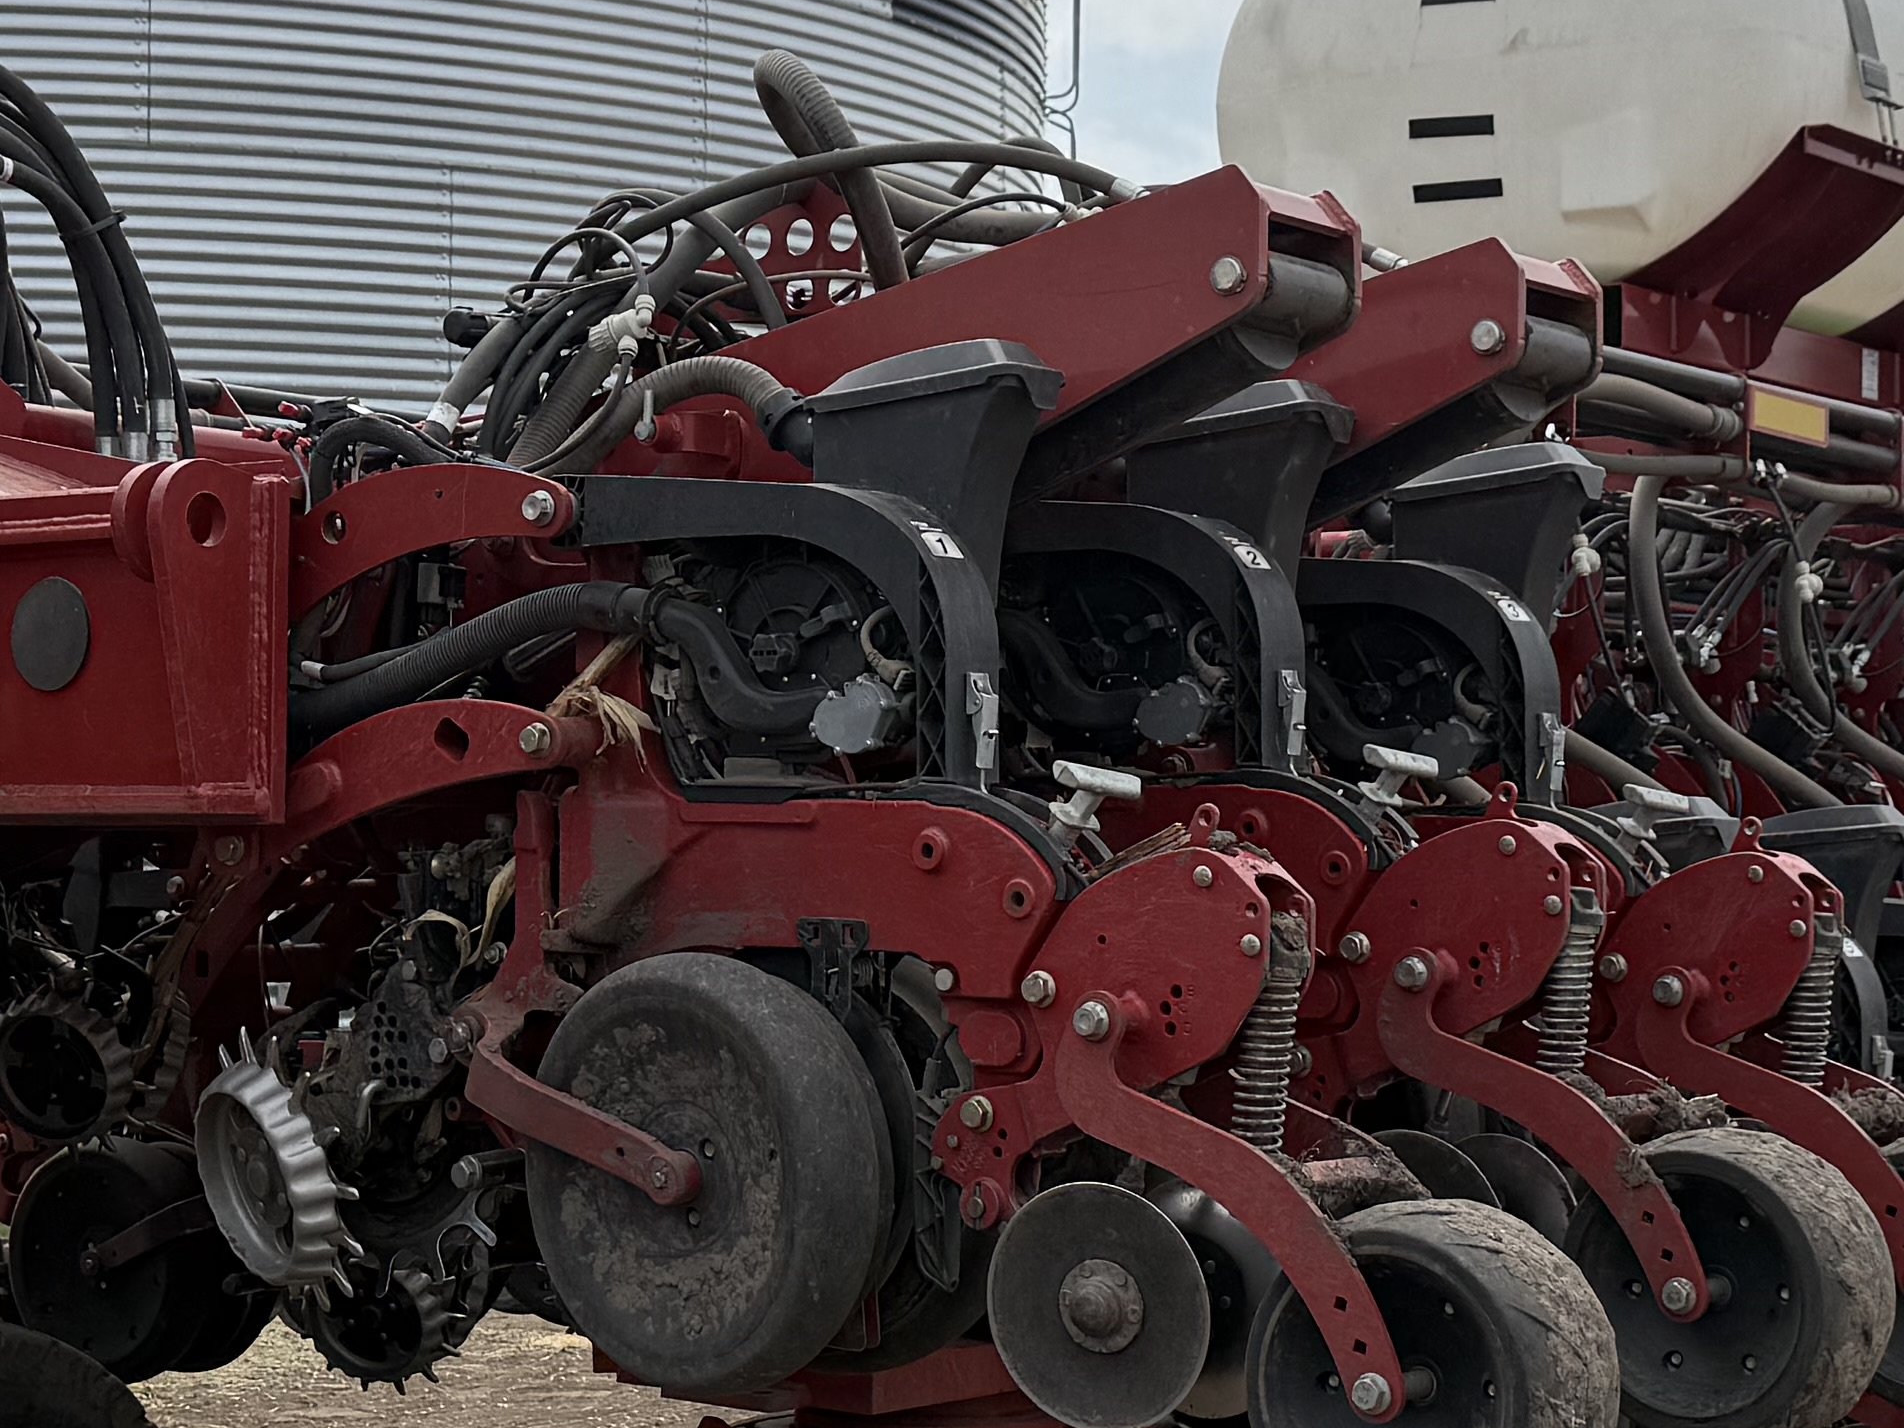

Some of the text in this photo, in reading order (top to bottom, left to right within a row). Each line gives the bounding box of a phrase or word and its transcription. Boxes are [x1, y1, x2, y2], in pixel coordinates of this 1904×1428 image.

[935, 537, 948, 555] 1
[1246, 550, 1261, 566] 2
[1507, 603, 1520, 618] 3
